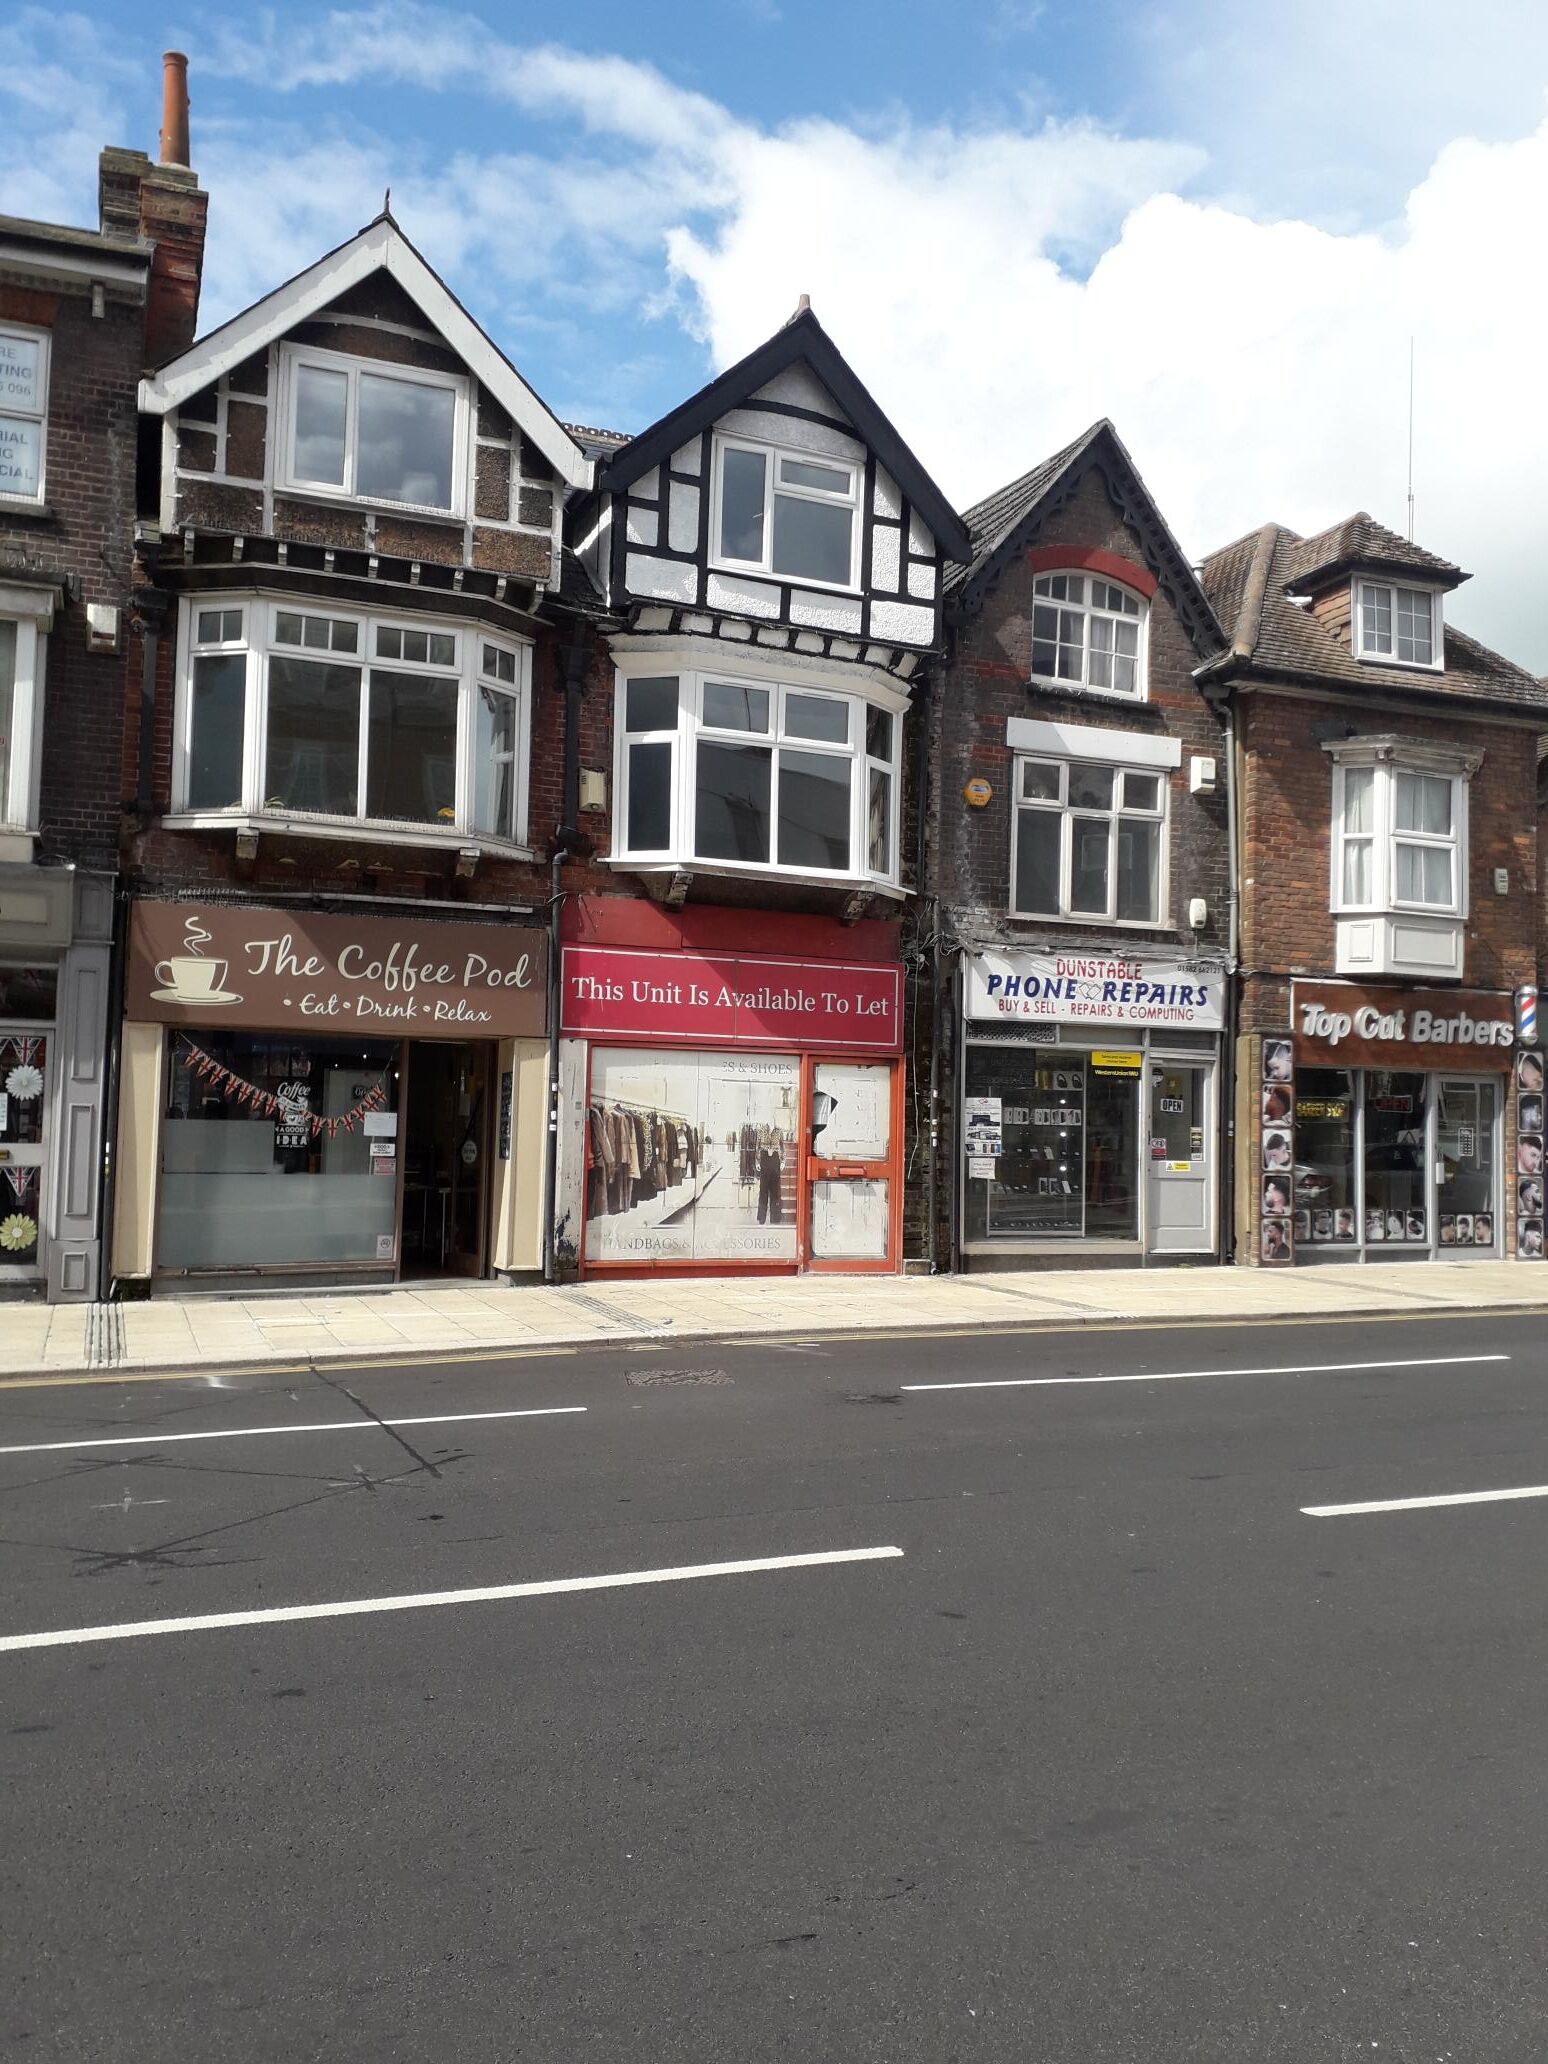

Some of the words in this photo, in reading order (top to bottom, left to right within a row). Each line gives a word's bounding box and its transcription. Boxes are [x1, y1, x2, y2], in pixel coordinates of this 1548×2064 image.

[244, 934, 325, 977] The
[337, 942, 456, 992] Coffee
[462, 952, 532, 989] Pod
[1056, 958, 1143, 981] DUNSTABLE
[571, 976, 624, 1001] This
[630, 981, 682, 1004] Unit
[688, 984, 709, 1006] Is
[714, 986, 816, 1012] Available
[821, 993, 849, 1014] To
[855, 995, 889, 1016] Let
[986, 974, 1078, 1000] PHONE
[1102, 981, 1209, 1007] REPAIRS
[298, 993, 341, 1016] Eat
[355, 995, 418, 1018] Drink
[433, 1000, 492, 1022] Relax
[999, 999, 1019, 1013] BUY
[1023, 1001, 1030, 1013] &
[1034, 1002, 1056, 1015] SELL
[1070, 1004, 1113, 1018] REPAIRS
[1117, 1006, 1124, 1018] &
[1129, 1006, 1194, 1021] COMPUTING
[1300, 1003, 1352, 1046] Top
[1353, 1006, 1406, 1041] Cut
[1410, 1009, 1514, 1047] Barbers
[750, 1062, 793, 1075] SHOES
[277, 1081, 311, 1100] Coffee
[1162, 1099, 1182, 1112] OPEN
[276, 1135, 308, 1145] IDEA
